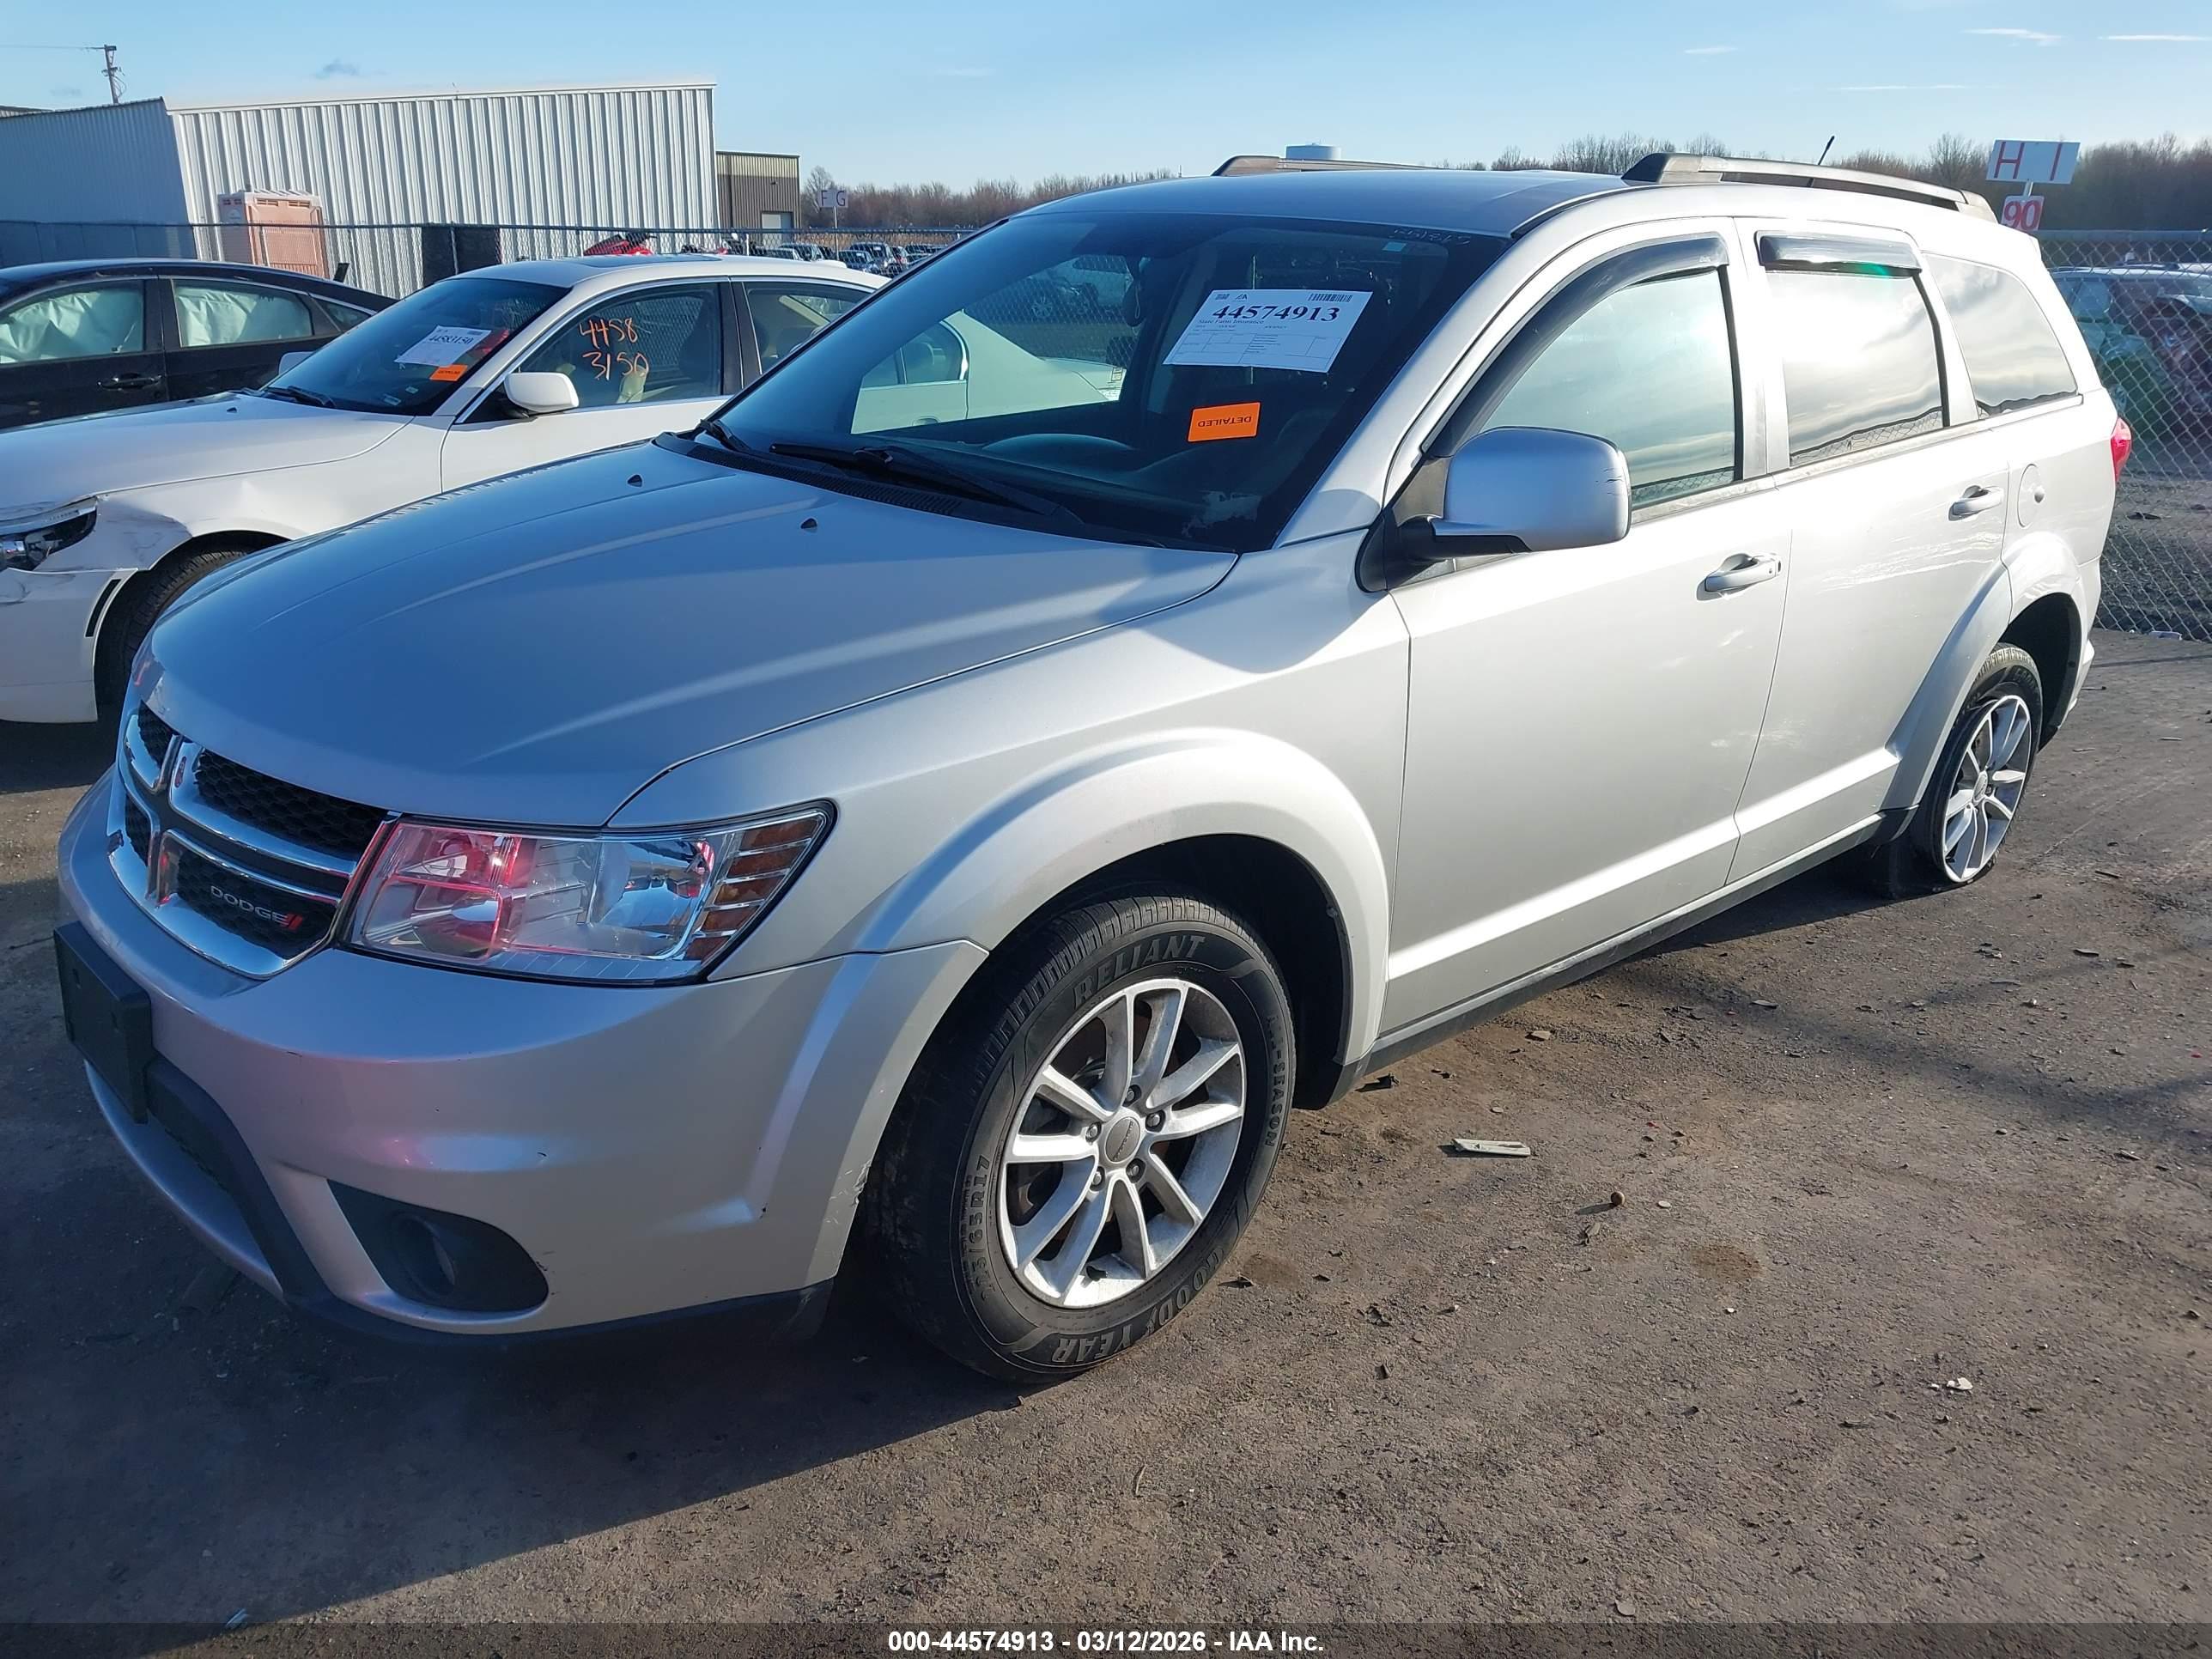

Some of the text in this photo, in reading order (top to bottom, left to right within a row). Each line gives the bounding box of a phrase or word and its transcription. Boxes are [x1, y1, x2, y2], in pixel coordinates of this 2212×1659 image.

[1993, 142, 2025, 179] H
[821, 190, 846, 206] F G
[2003, 200, 2041, 231] 90
[1212, 305, 1340, 322] 44574913
[579, 317, 638, 349] 4458
[582, 351, 649, 380] 3150
[1198, 415, 1252, 428] DETAILED
[210, 885, 289, 926] DODGE
[1074, 934, 1206, 1010] RELIANT
